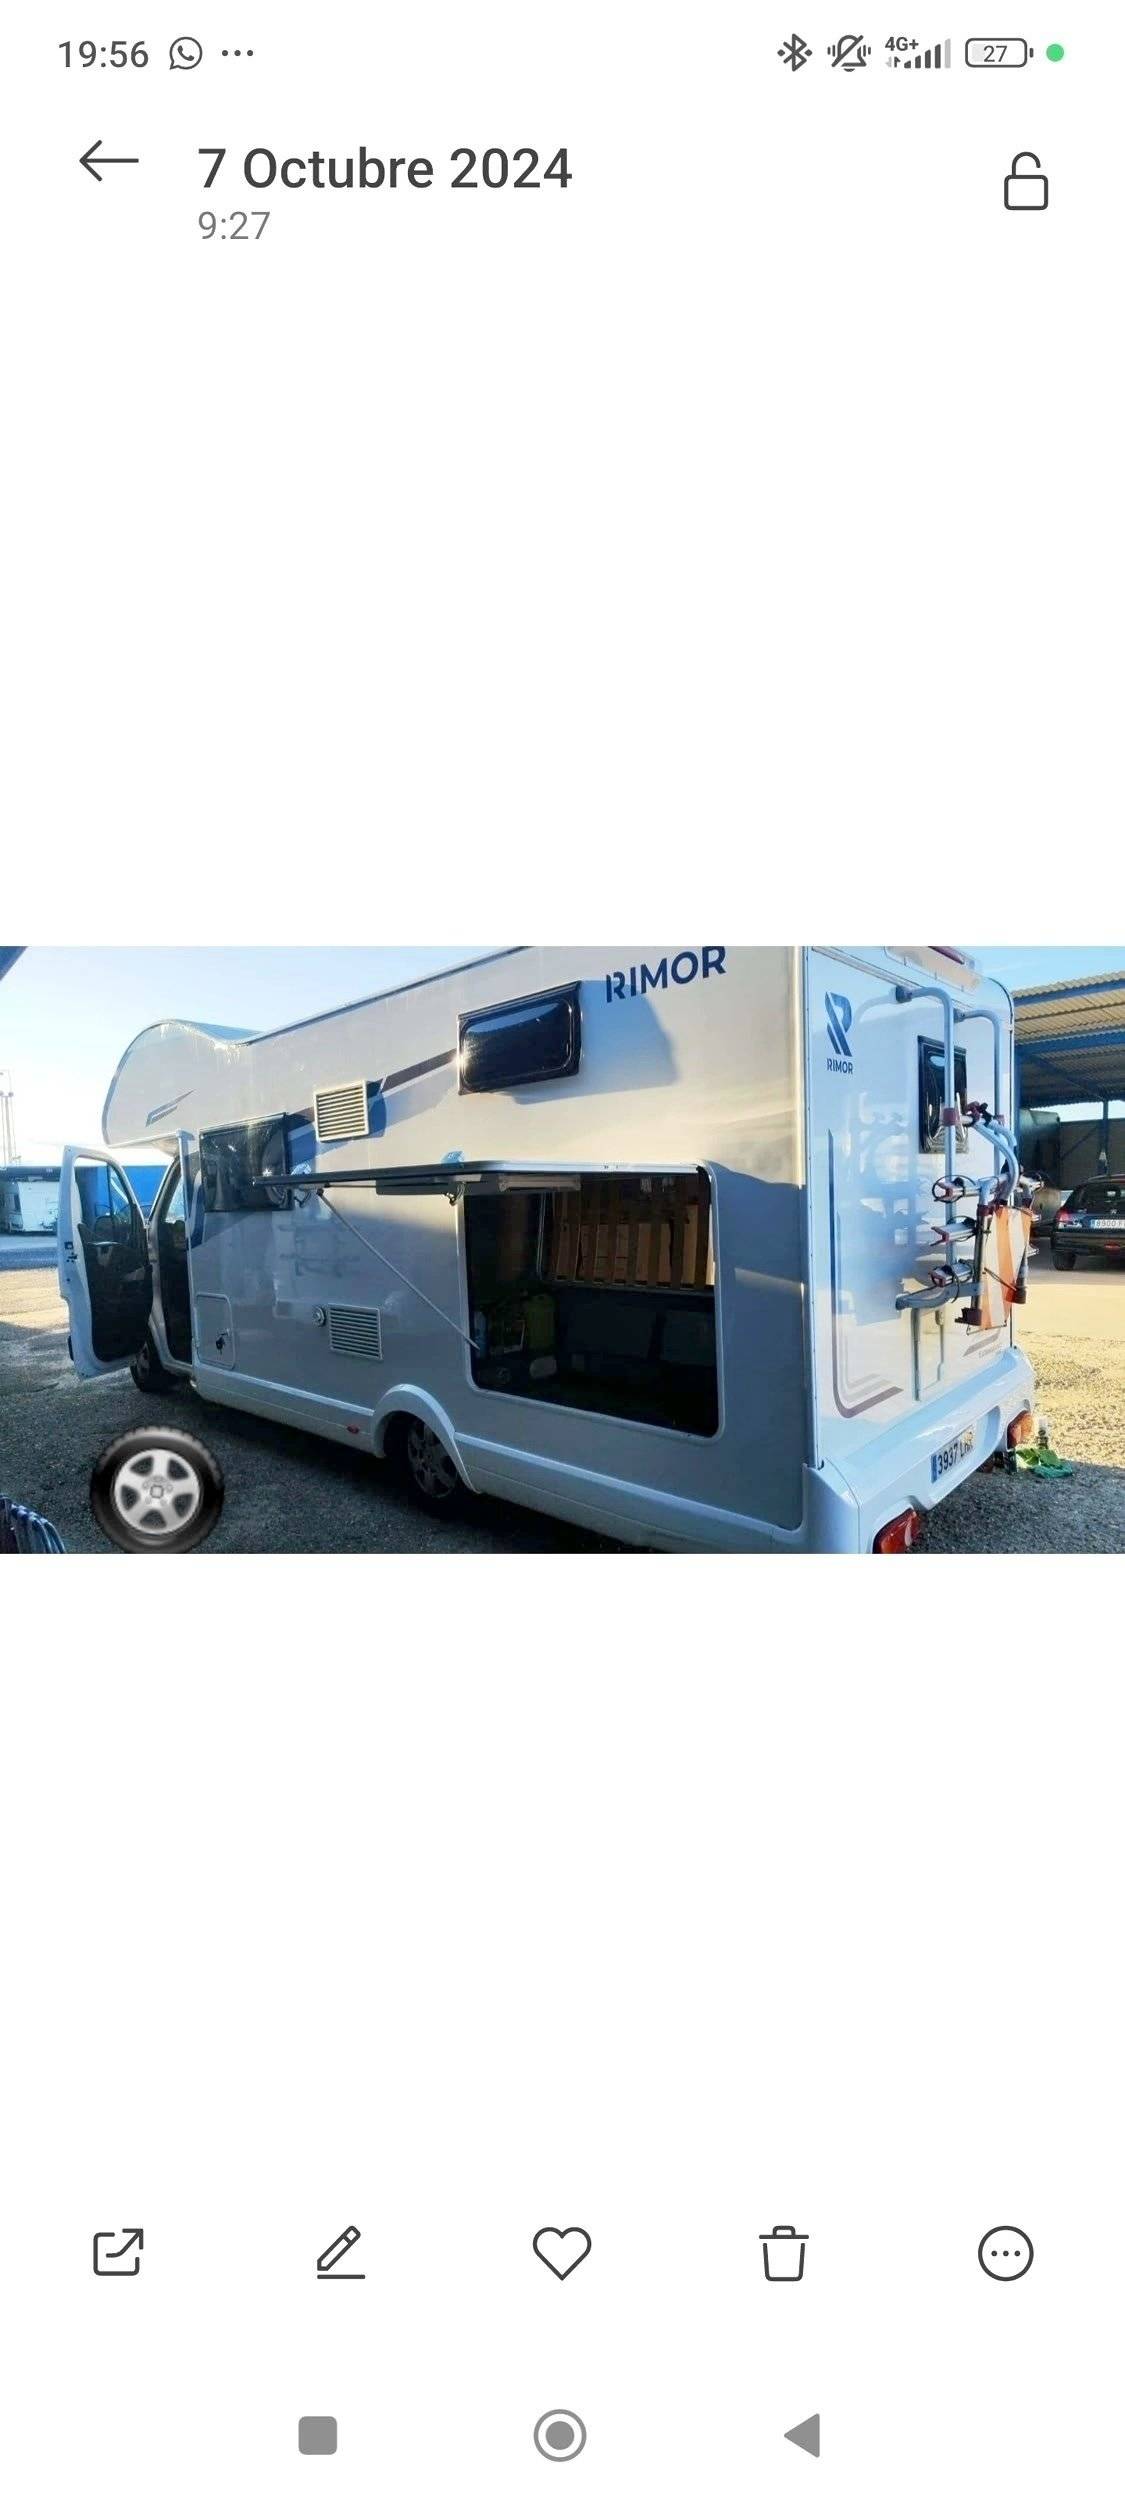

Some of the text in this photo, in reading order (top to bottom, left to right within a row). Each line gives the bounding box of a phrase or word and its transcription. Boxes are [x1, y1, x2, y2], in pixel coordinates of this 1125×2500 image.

[605, 946, 727, 1003] RIMOR
[826, 1058, 854, 1075] RIMOR
[937, 1441, 958, 1475] 3937
